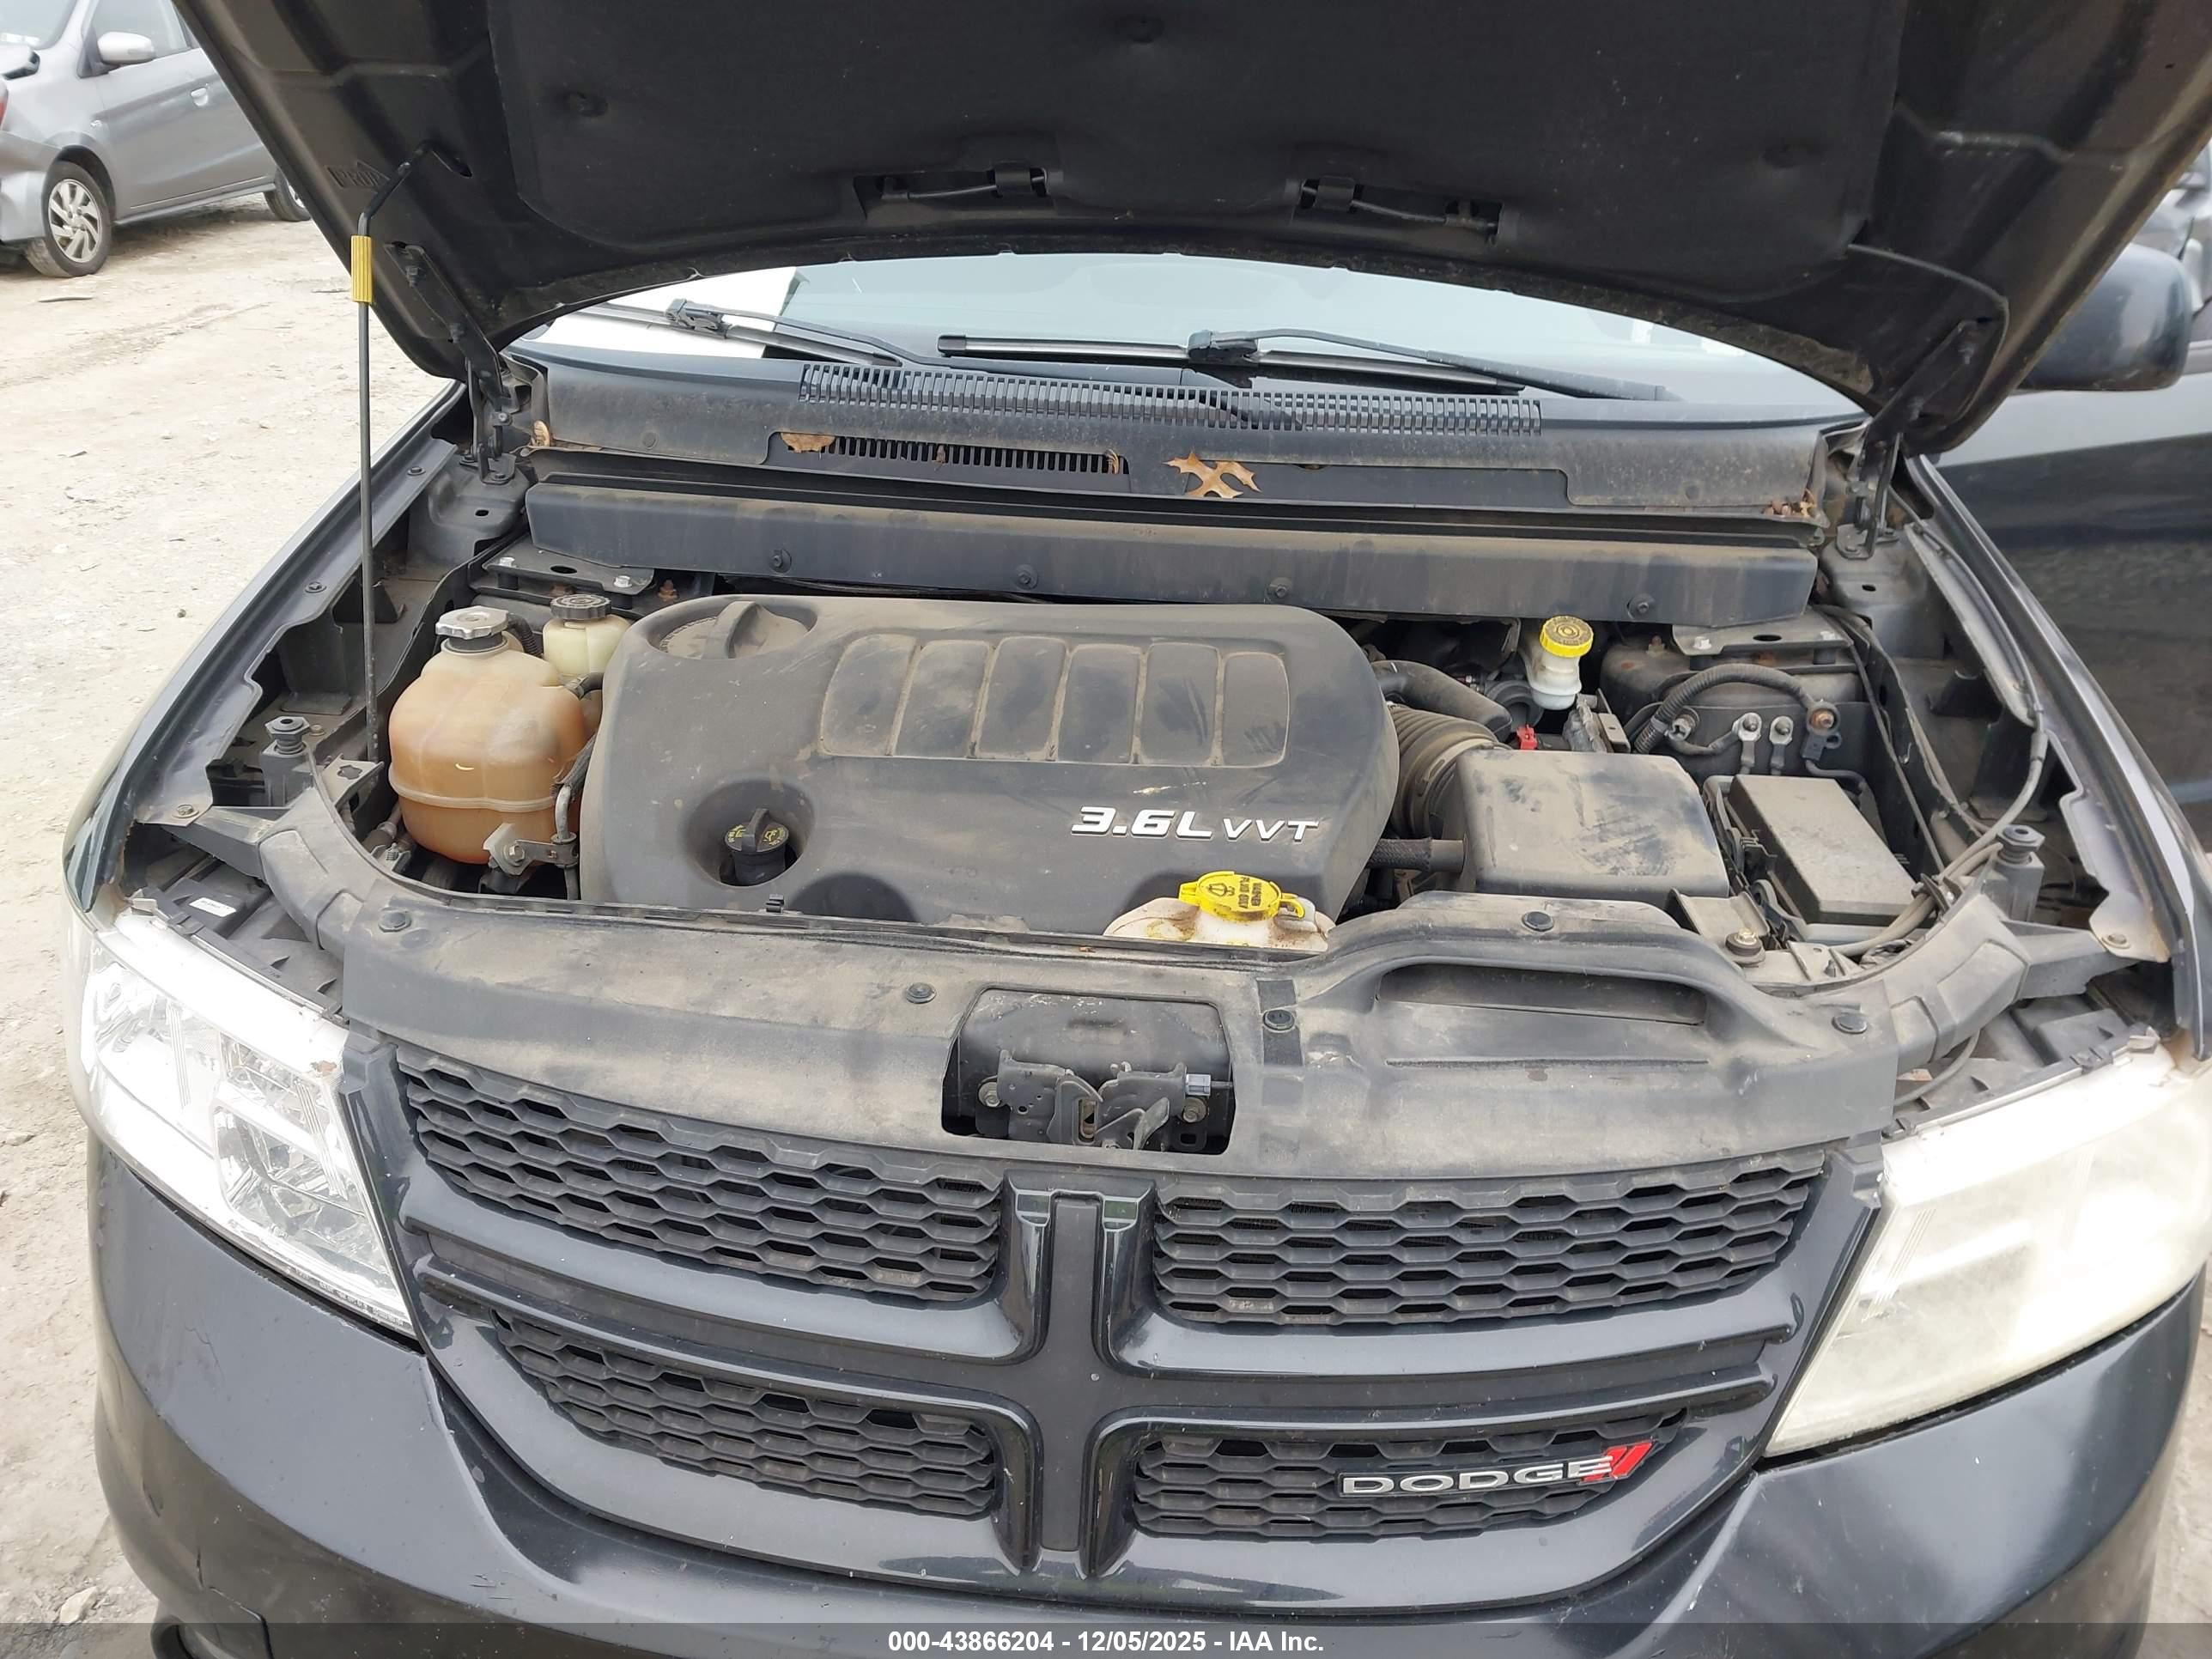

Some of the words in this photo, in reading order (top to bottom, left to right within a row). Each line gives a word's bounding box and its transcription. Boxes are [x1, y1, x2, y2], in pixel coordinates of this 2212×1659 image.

[1072, 806, 1212, 839] 3.6L
[1223, 817, 1319, 842] VVT
[1342, 1455, 1613, 1494] DODGE
